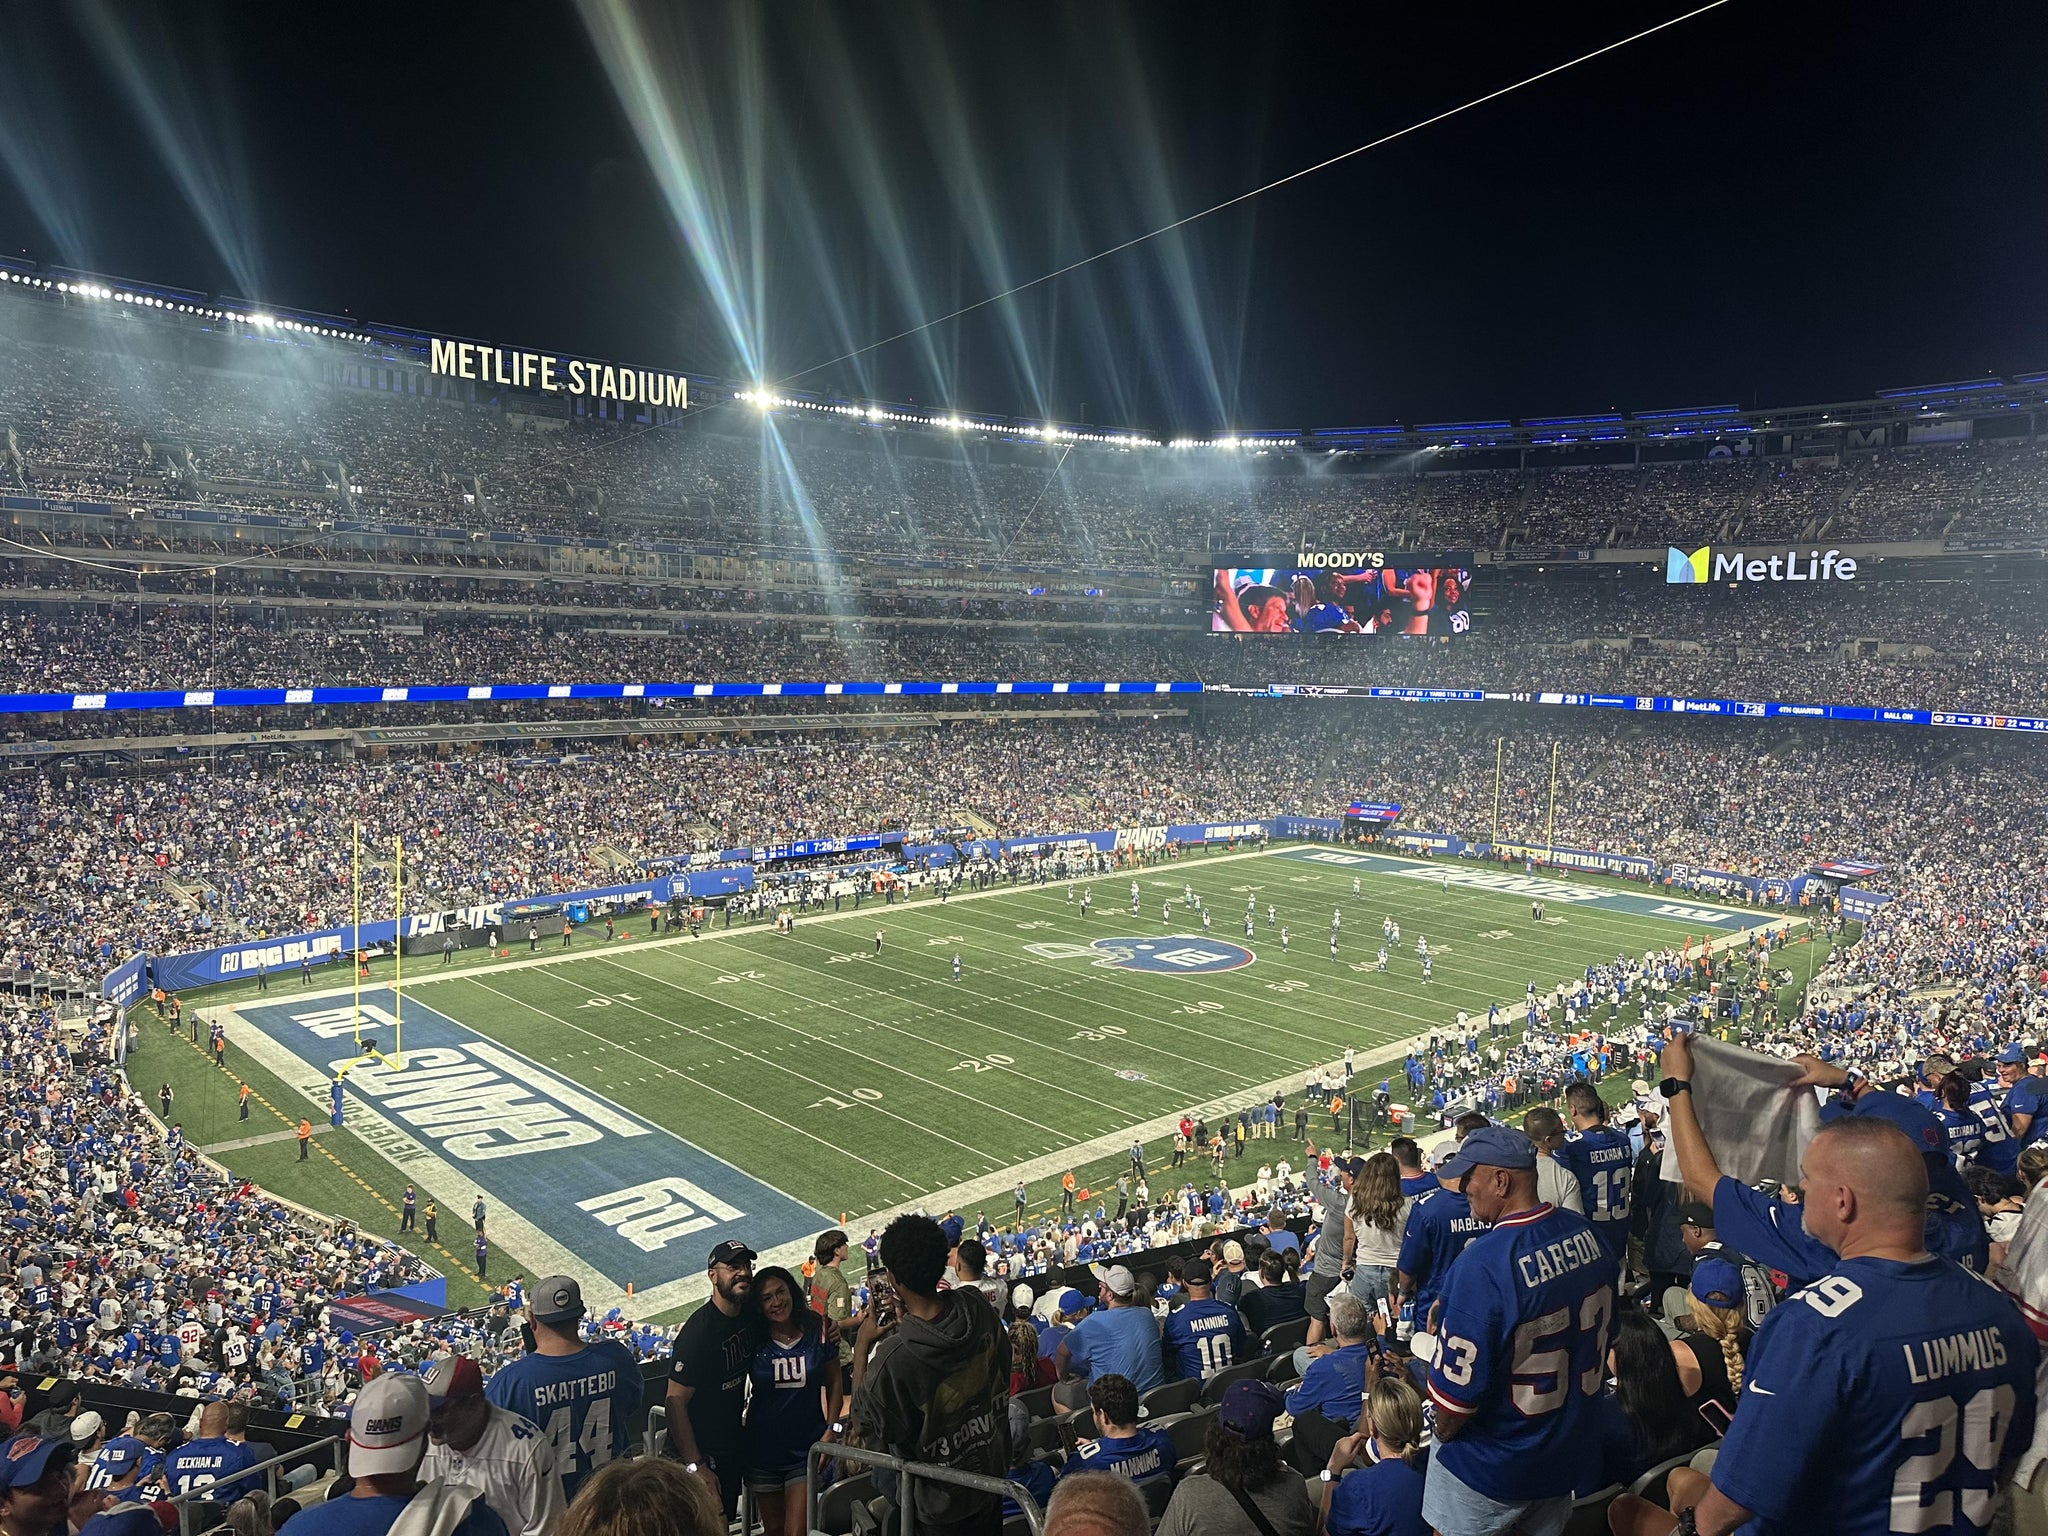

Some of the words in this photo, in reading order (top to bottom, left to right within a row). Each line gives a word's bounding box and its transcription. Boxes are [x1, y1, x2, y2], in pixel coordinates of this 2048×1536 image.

[430, 337, 558, 392] METLIFE
[568, 359, 688, 410] STADIUM
[1296, 552, 1384, 569] MOODY'S
[1714, 549, 1858, 582] MetLife
[1638, 698, 1651, 708] 25
[1686, 701, 1721, 712] MetLife
[1743, 704, 1764, 714] 7:26
[1792, 706, 1824, 715] QUARTER
[1883, 711, 1901, 720] BALL
[1902, 713, 1913, 721] ON
[1945, 715, 1956, 723] 22
[1971, 717, 1982, 725] 39
[2007, 719, 2017, 728] 22
[525, 724, 563, 734] MetLife
[638, 720, 681, 730] METLIFE
[683, 719, 723, 728] STADIUM
[261, 733, 286, 741] MetLife
[386, 729, 429, 739] MetLife
[795, 844, 805, 853] 4Q
[813, 841, 833, 853] 7:26
[834, 839, 846, 850] 25
[1114, 825, 1168, 851] GIANTS
[690, 850, 722, 865] GIANTS
[1553, 852, 1607, 870] FOOTBALL
[1607, 858, 1648, 876] GIANTS
[1673, 866, 1686, 877] 25
[219, 951, 239, 974] GO
[240, 944, 283, 971] BIG
[283, 934, 342, 964] BLUE
[1265, 979, 1311, 995] 50
[1183, 1000, 1225, 1015] 40
[1076, 1024, 1128, 1042] 30
[957, 1053, 1016, 1074] 20
[328, 1046, 606, 1161] GIANTS
[819, 1087, 884, 1111] 10
[357, 1119, 431, 1163] NEVER
[1590, 1149, 1623, 1164] BECKHAM
[1591, 1165, 1631, 1223] 13
[575, 1176, 748, 1252] ny
[1517, 1228, 1601, 1289] CARSON
[35, 1291, 48, 1304] 10
[261, 1299, 271, 1311] 10
[1190, 1314, 1229, 1333] MANNING
[181, 1329, 198, 1344] 92
[228, 1343, 242, 1358] 13
[304, 1351, 313, 1366] 6
[1196, 1333, 1233, 1380] 10
[1511, 1285, 1615, 1418] 53
[1903, 1326, 2008, 1385] LUMMUS
[770, 1354, 807, 1389] ny
[534, 1370, 617, 1408] SKATTEBO
[365, 1414, 403, 1436] GIANTS
[550, 1397, 614, 1474] 44
[111, 1449, 126, 1461] ny
[176, 1457, 211, 1470] BECKHAM
[211, 1456, 223, 1468] JR
[1109, 1448, 1161, 1478] MANNING
[1888, 1384, 2016, 1534] 29
